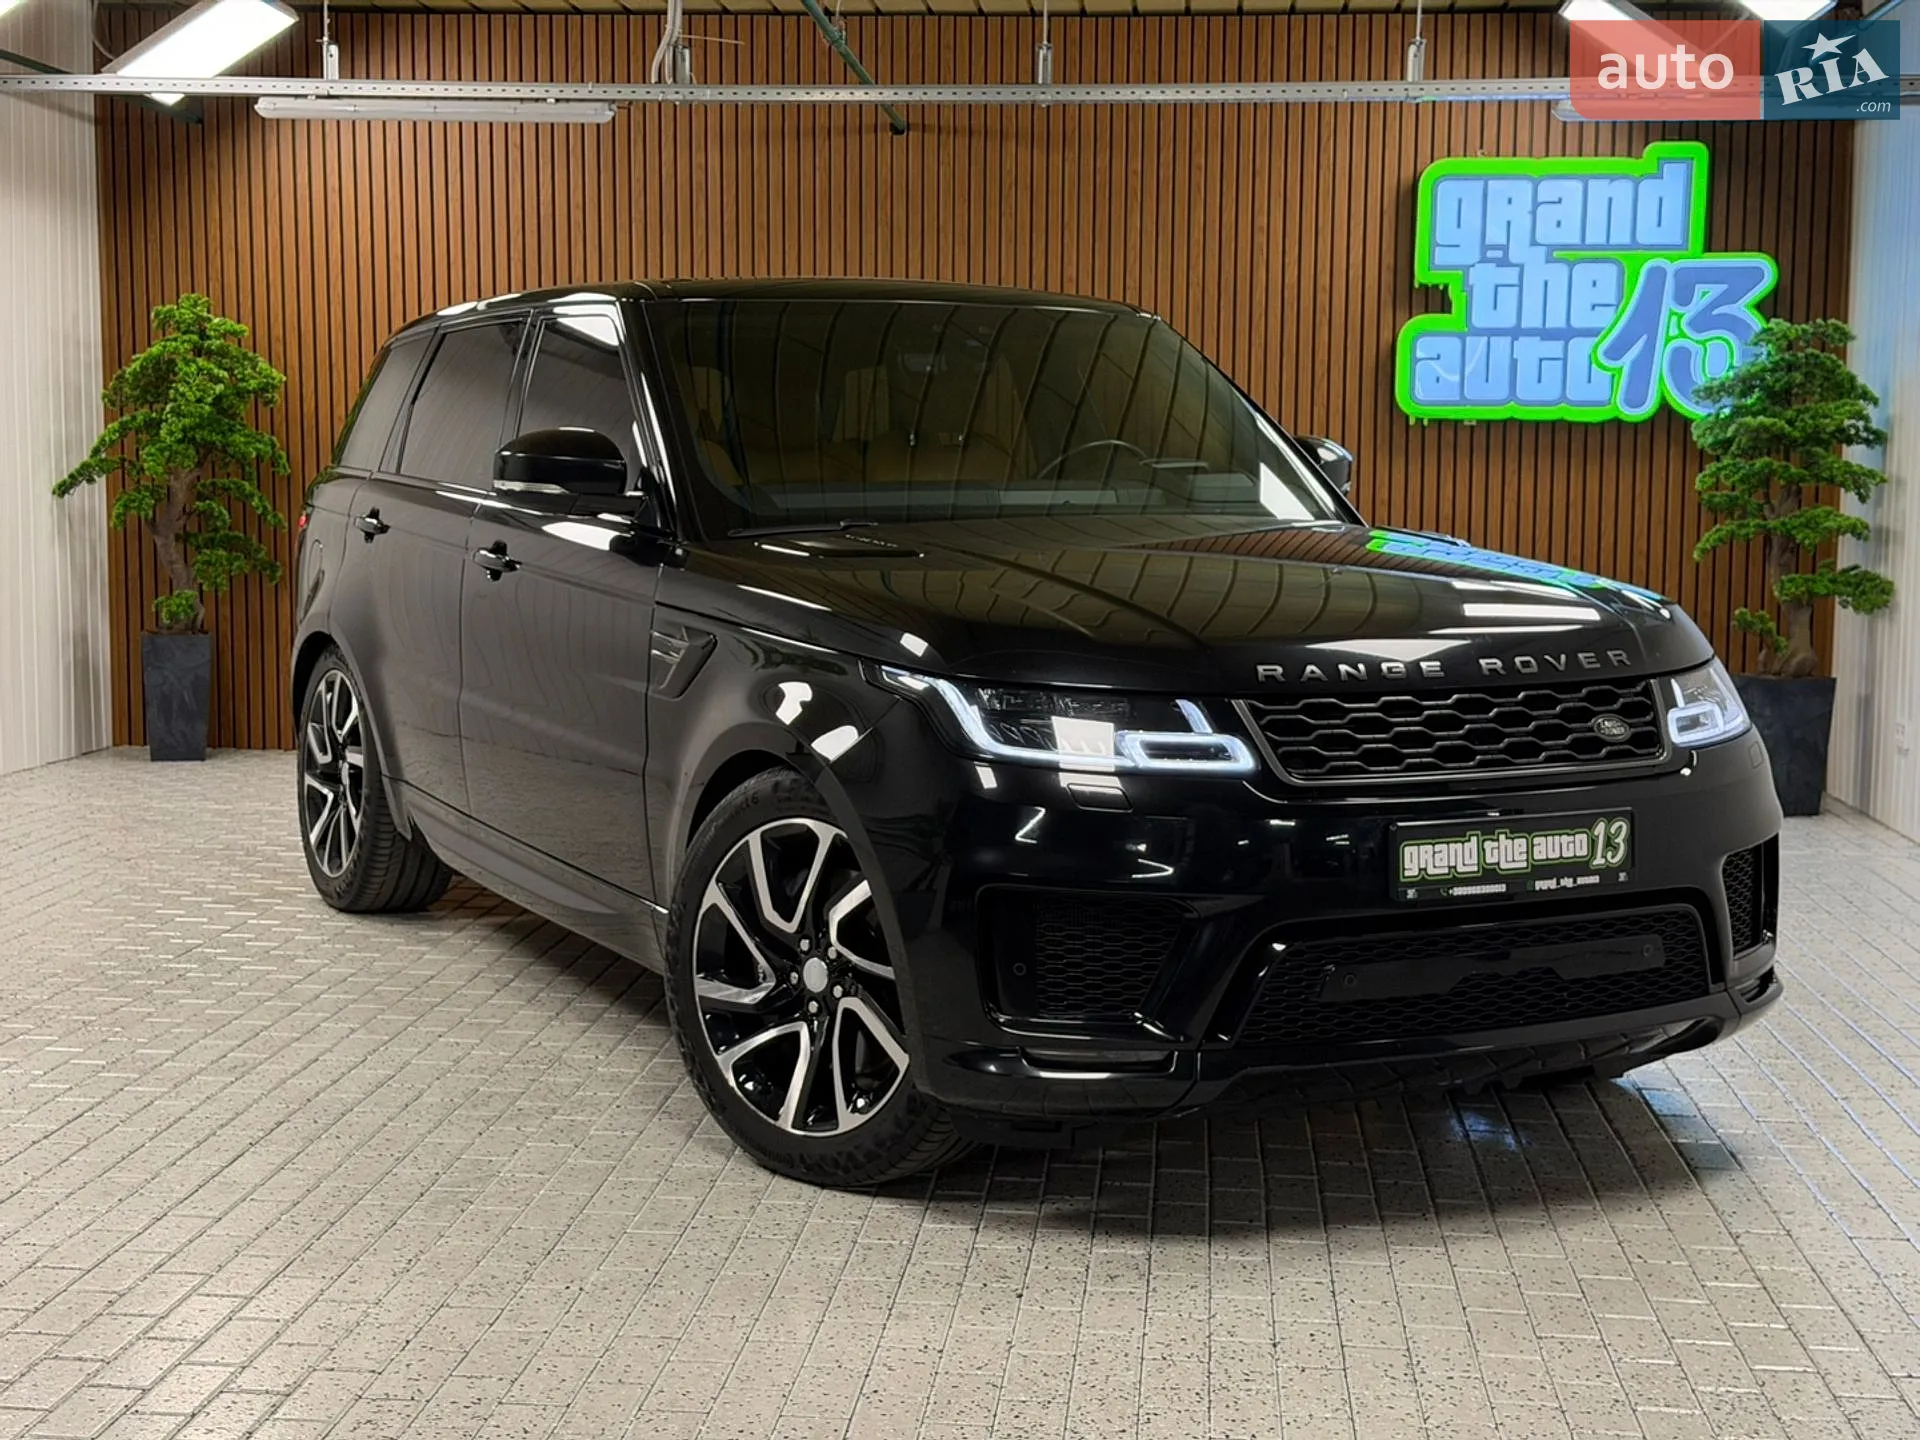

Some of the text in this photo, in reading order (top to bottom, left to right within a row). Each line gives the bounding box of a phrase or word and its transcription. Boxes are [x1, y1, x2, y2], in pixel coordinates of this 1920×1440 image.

[1467, 247, 1621, 329] the
[1414, 259, 1772, 413] auto 13
[1256, 649, 1632, 683] RANGE ROVER
[1482, 833, 1528, 870] the
[1532, 832, 1588, 860] auto
[1591, 819, 1629, 866] 13
